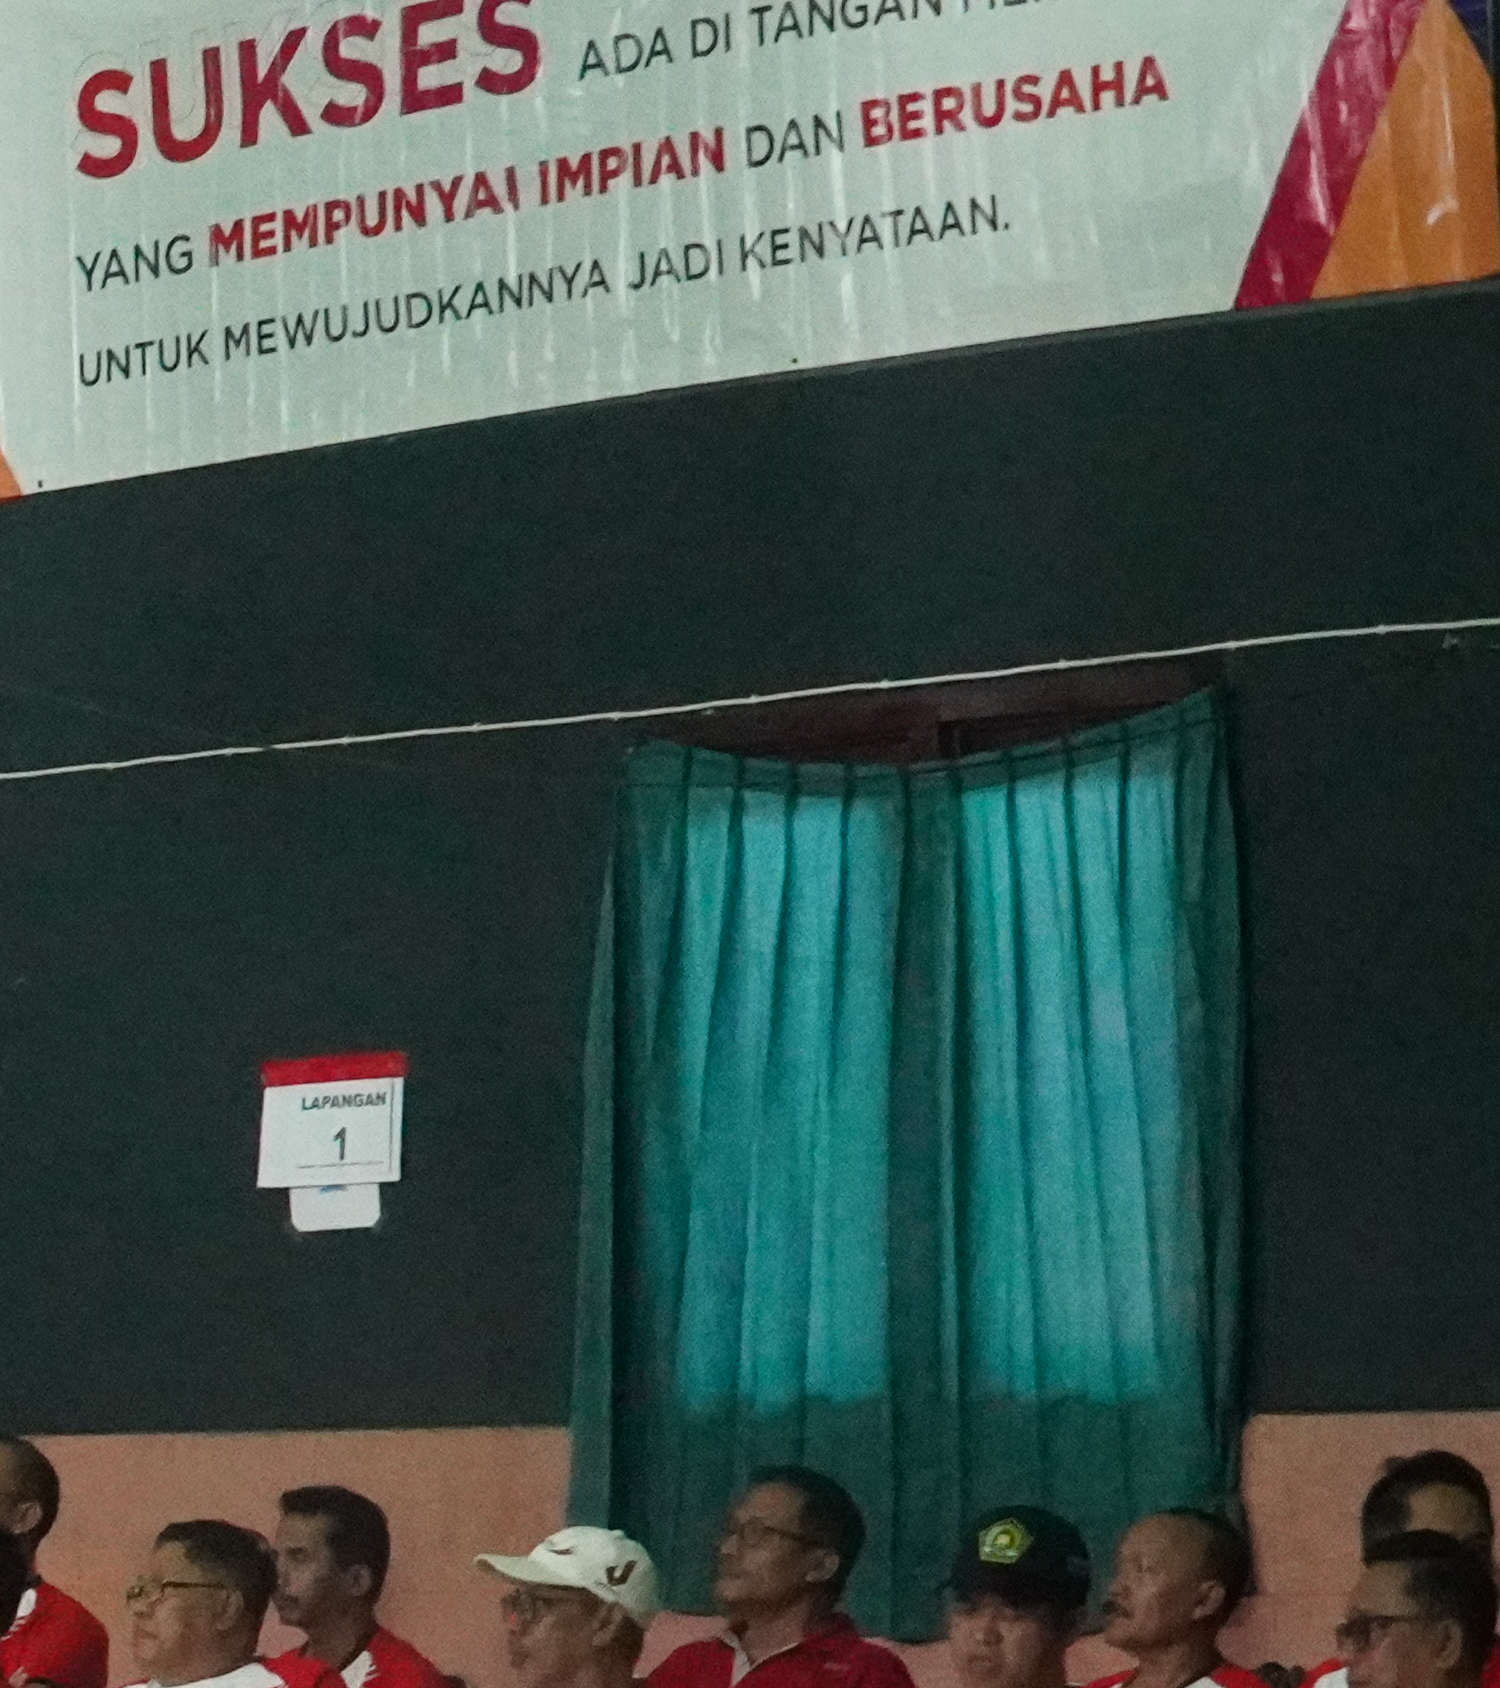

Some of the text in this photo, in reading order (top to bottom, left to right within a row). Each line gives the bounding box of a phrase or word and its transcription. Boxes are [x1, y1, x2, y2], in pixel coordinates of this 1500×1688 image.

[75, 0, 540, 179] SUKSES
[577, 25, 673, 82] ADA
[689, 13, 733, 60] DI
[76, 55, 1169, 293] YANG MEMPUNYAI IMPIAN DAN BERUSAHA
[79, 195, 1011, 387] UNTUK MEWUJUDKANNYA JADI KENYATAAN.
[301, 1092, 387, 1111] LAPANGAN
[333, 1126, 347, 1161] 1
